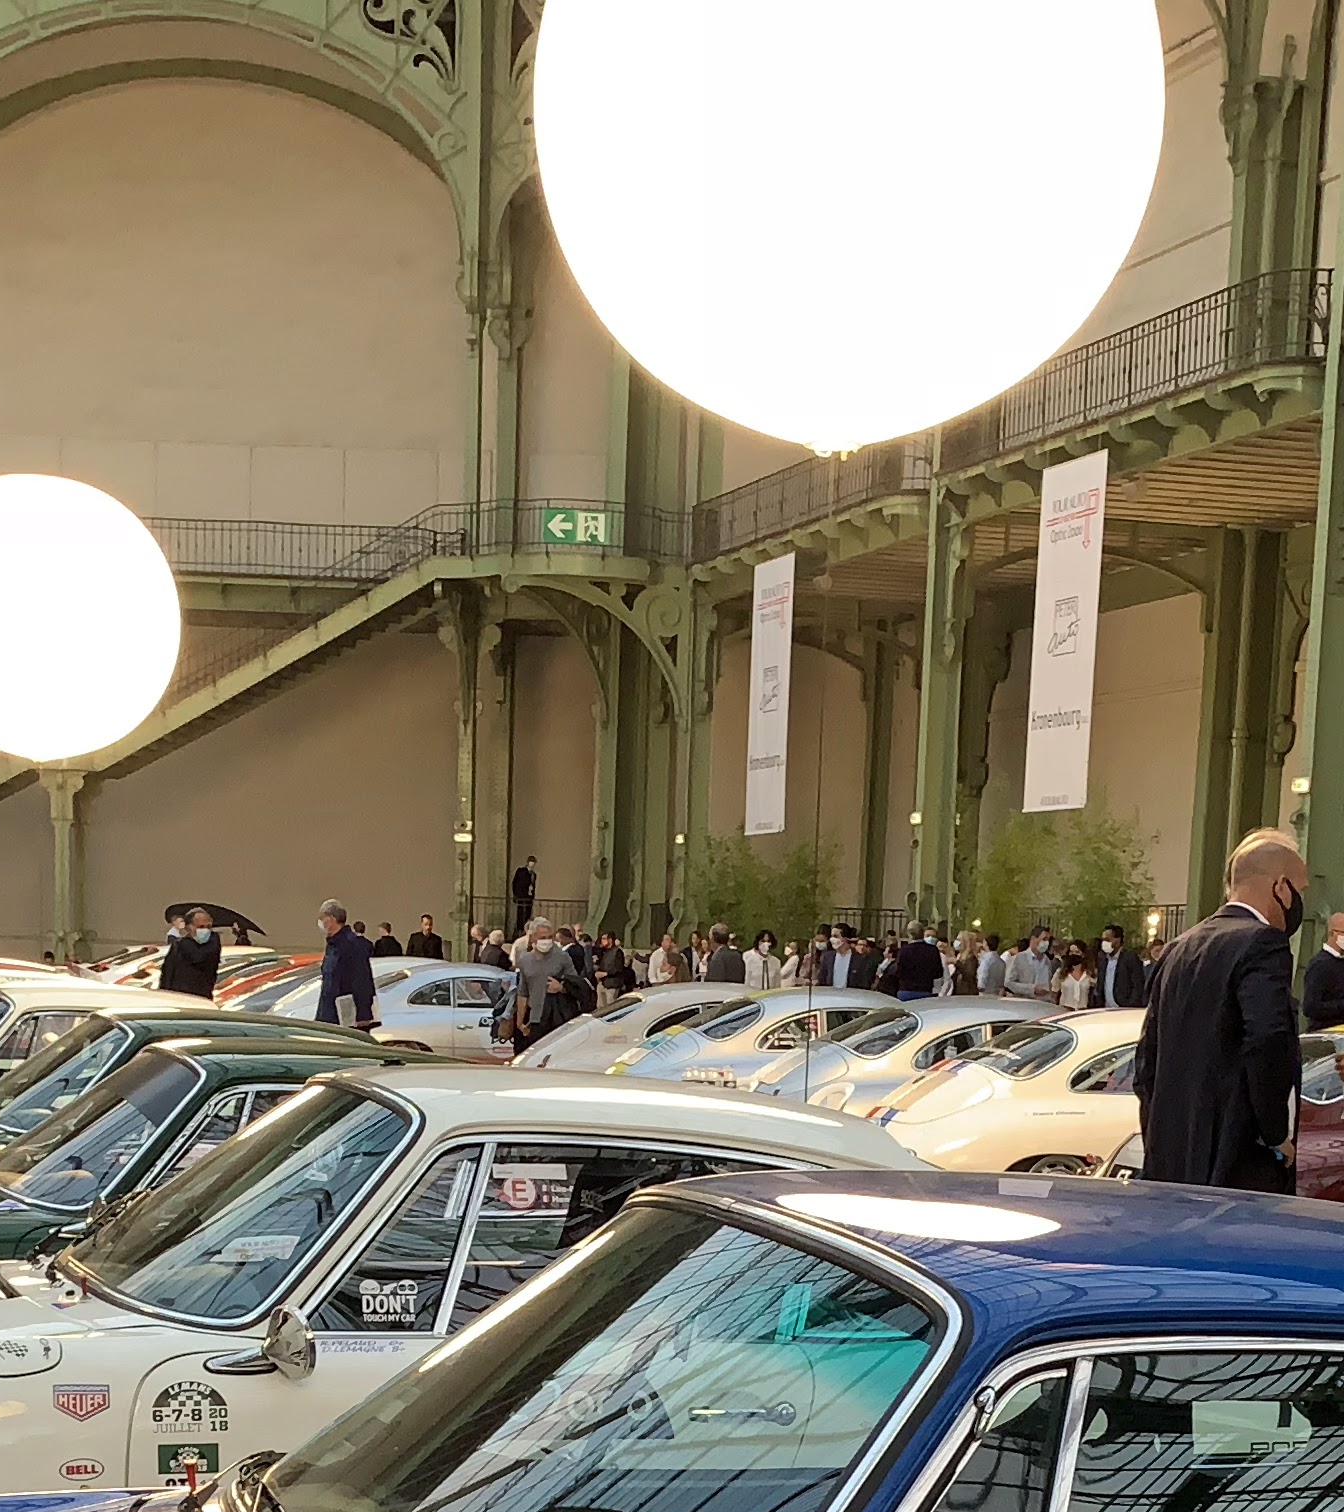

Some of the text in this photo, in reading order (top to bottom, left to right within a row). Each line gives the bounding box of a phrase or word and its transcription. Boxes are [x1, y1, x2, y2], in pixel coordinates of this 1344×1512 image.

[1031, 706, 1081, 731] Kronenbourg
[361, 1295, 418, 1314] DON'T
[363, 1313, 416, 1323] TOUCH MY CAR
[58, 1394, 104, 1416] HEUER
[152, 1407, 228, 1423] 6-7-8 20
[153, 1420, 229, 1434] JUILLET 18
[65, 1464, 99, 1476] BELL
